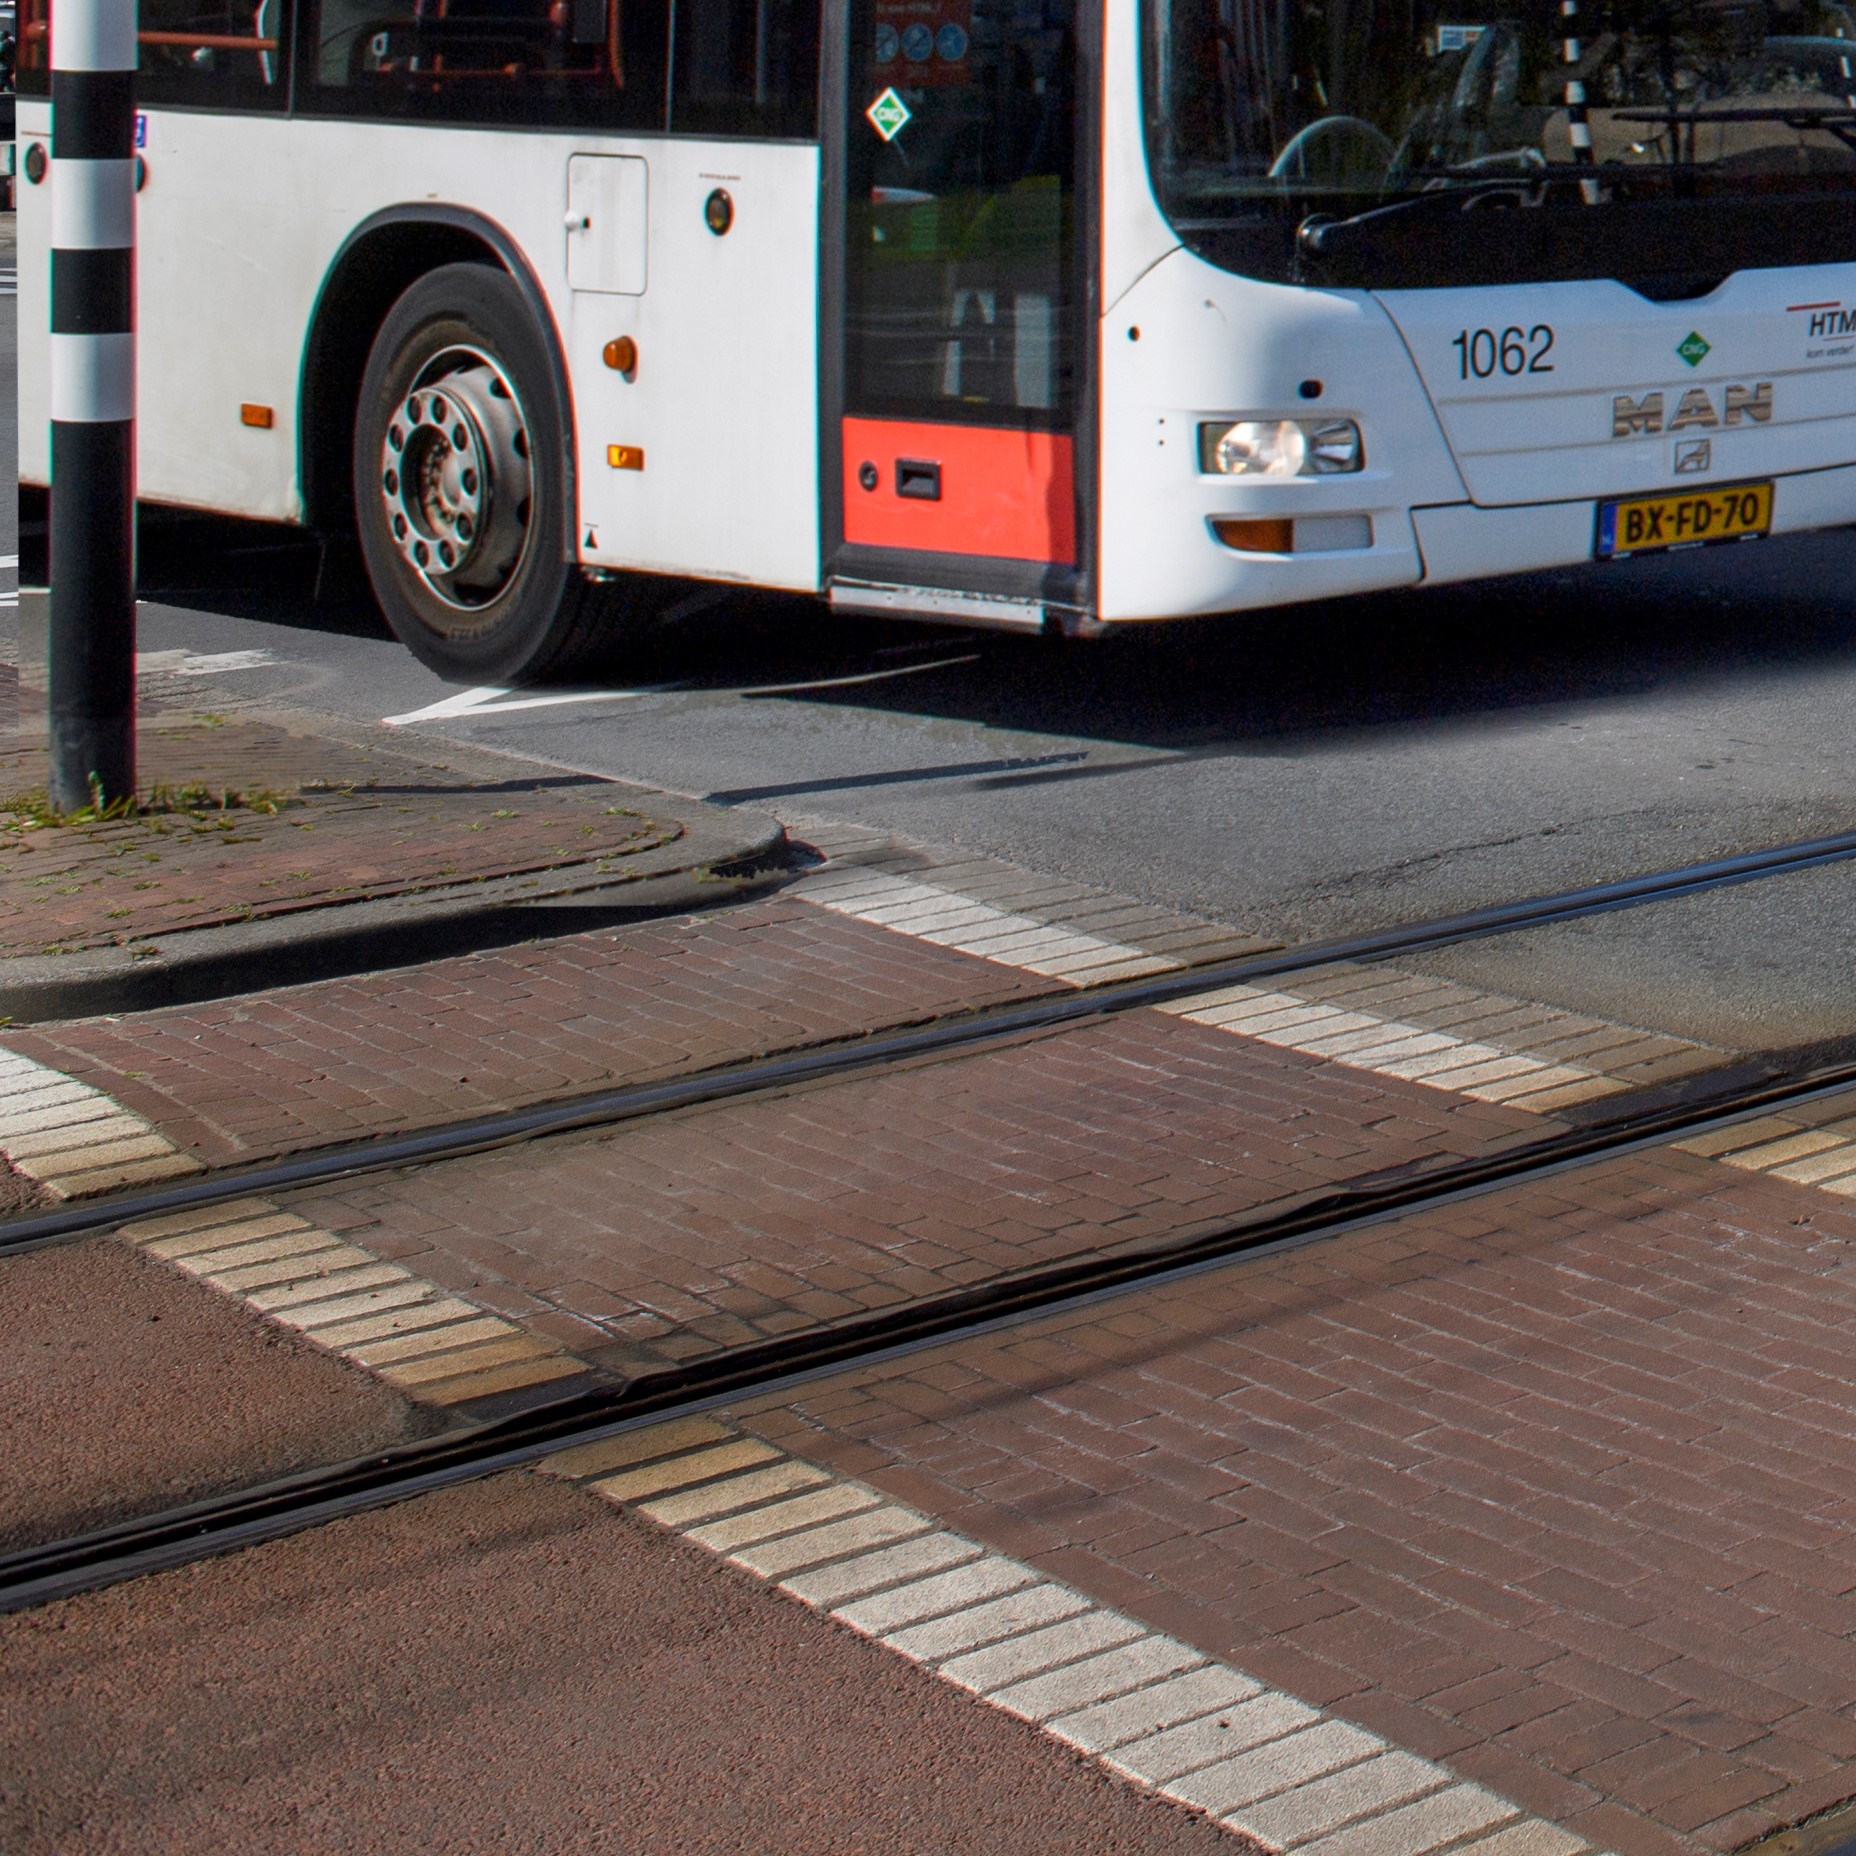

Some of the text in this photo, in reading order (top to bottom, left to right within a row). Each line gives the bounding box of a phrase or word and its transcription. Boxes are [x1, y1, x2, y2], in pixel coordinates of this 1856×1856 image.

[1452, 323, 1555, 380] 1062
[1611, 382, 1774, 438] MAN
[1625, 492, 1759, 544] BX-FD-70
